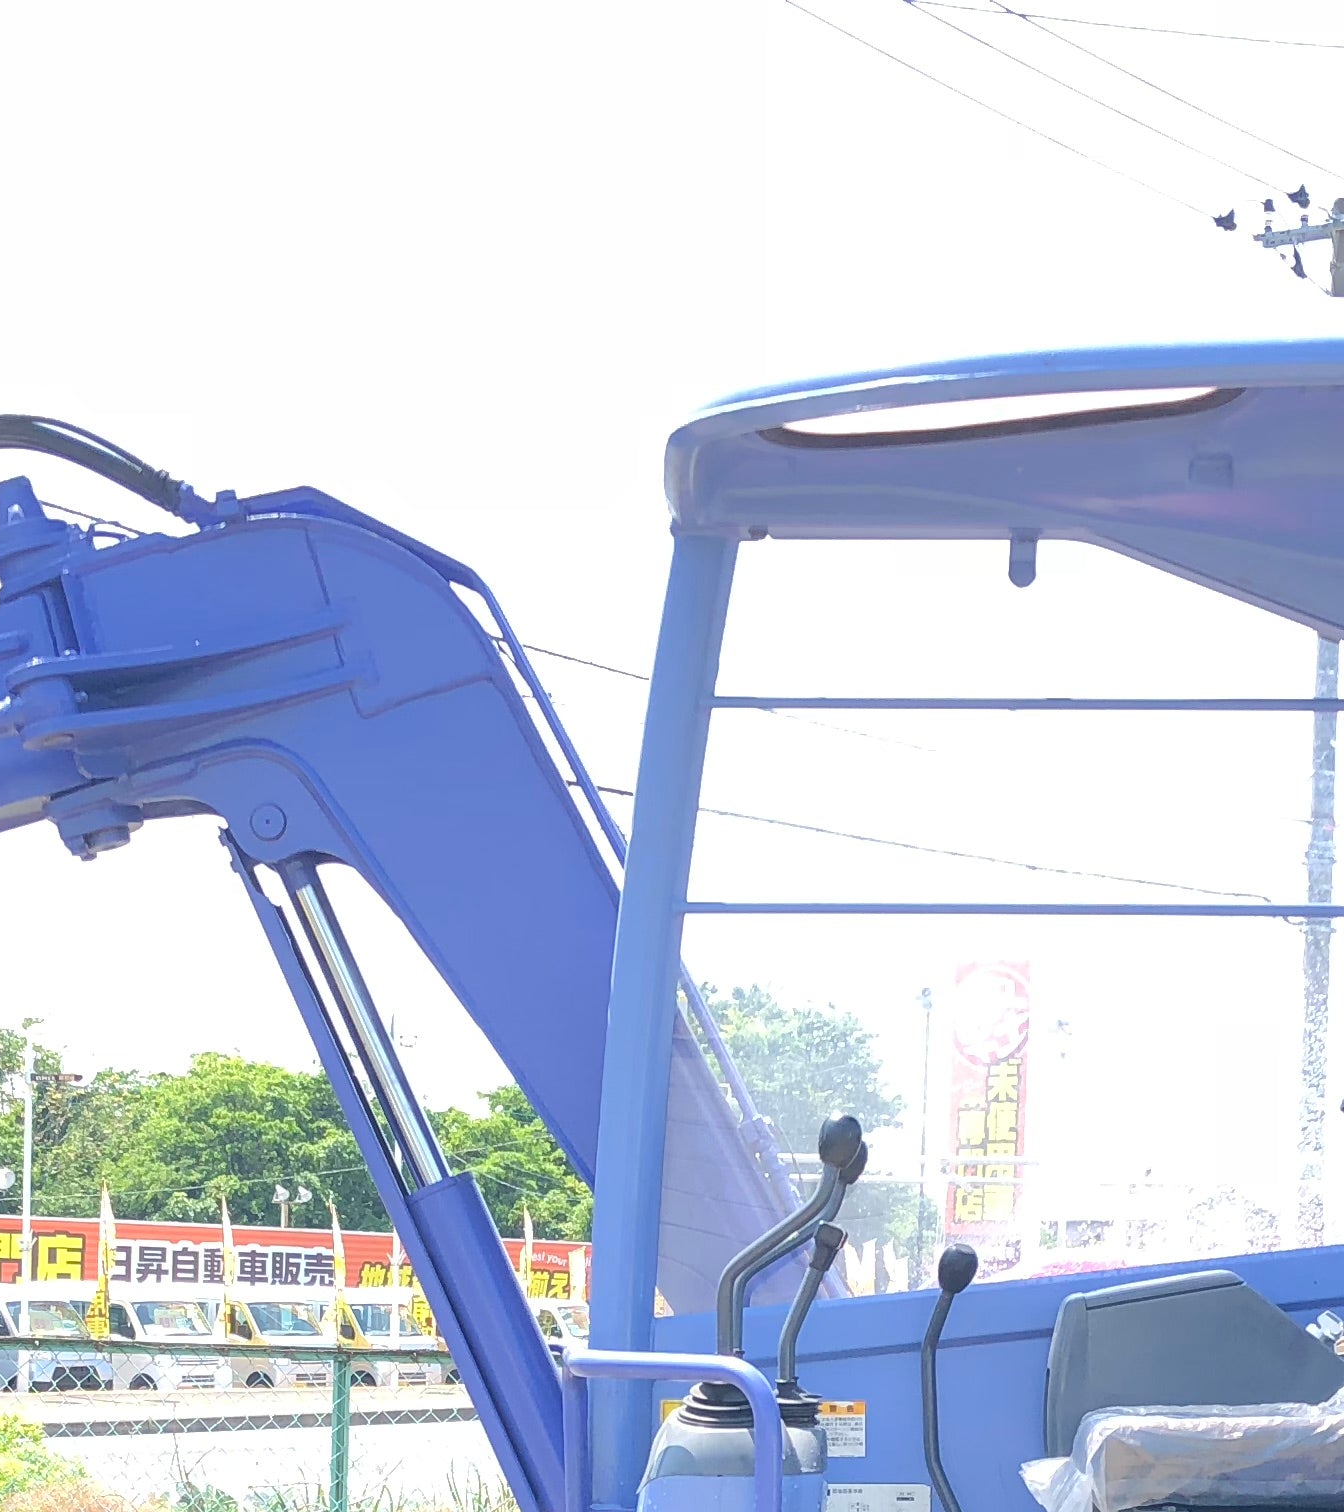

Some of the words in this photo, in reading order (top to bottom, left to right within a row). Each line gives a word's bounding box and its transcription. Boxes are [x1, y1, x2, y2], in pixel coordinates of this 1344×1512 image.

[109, 1245, 335, 1287] 日昇自動車販売
[546, 1253, 568, 1267] your
